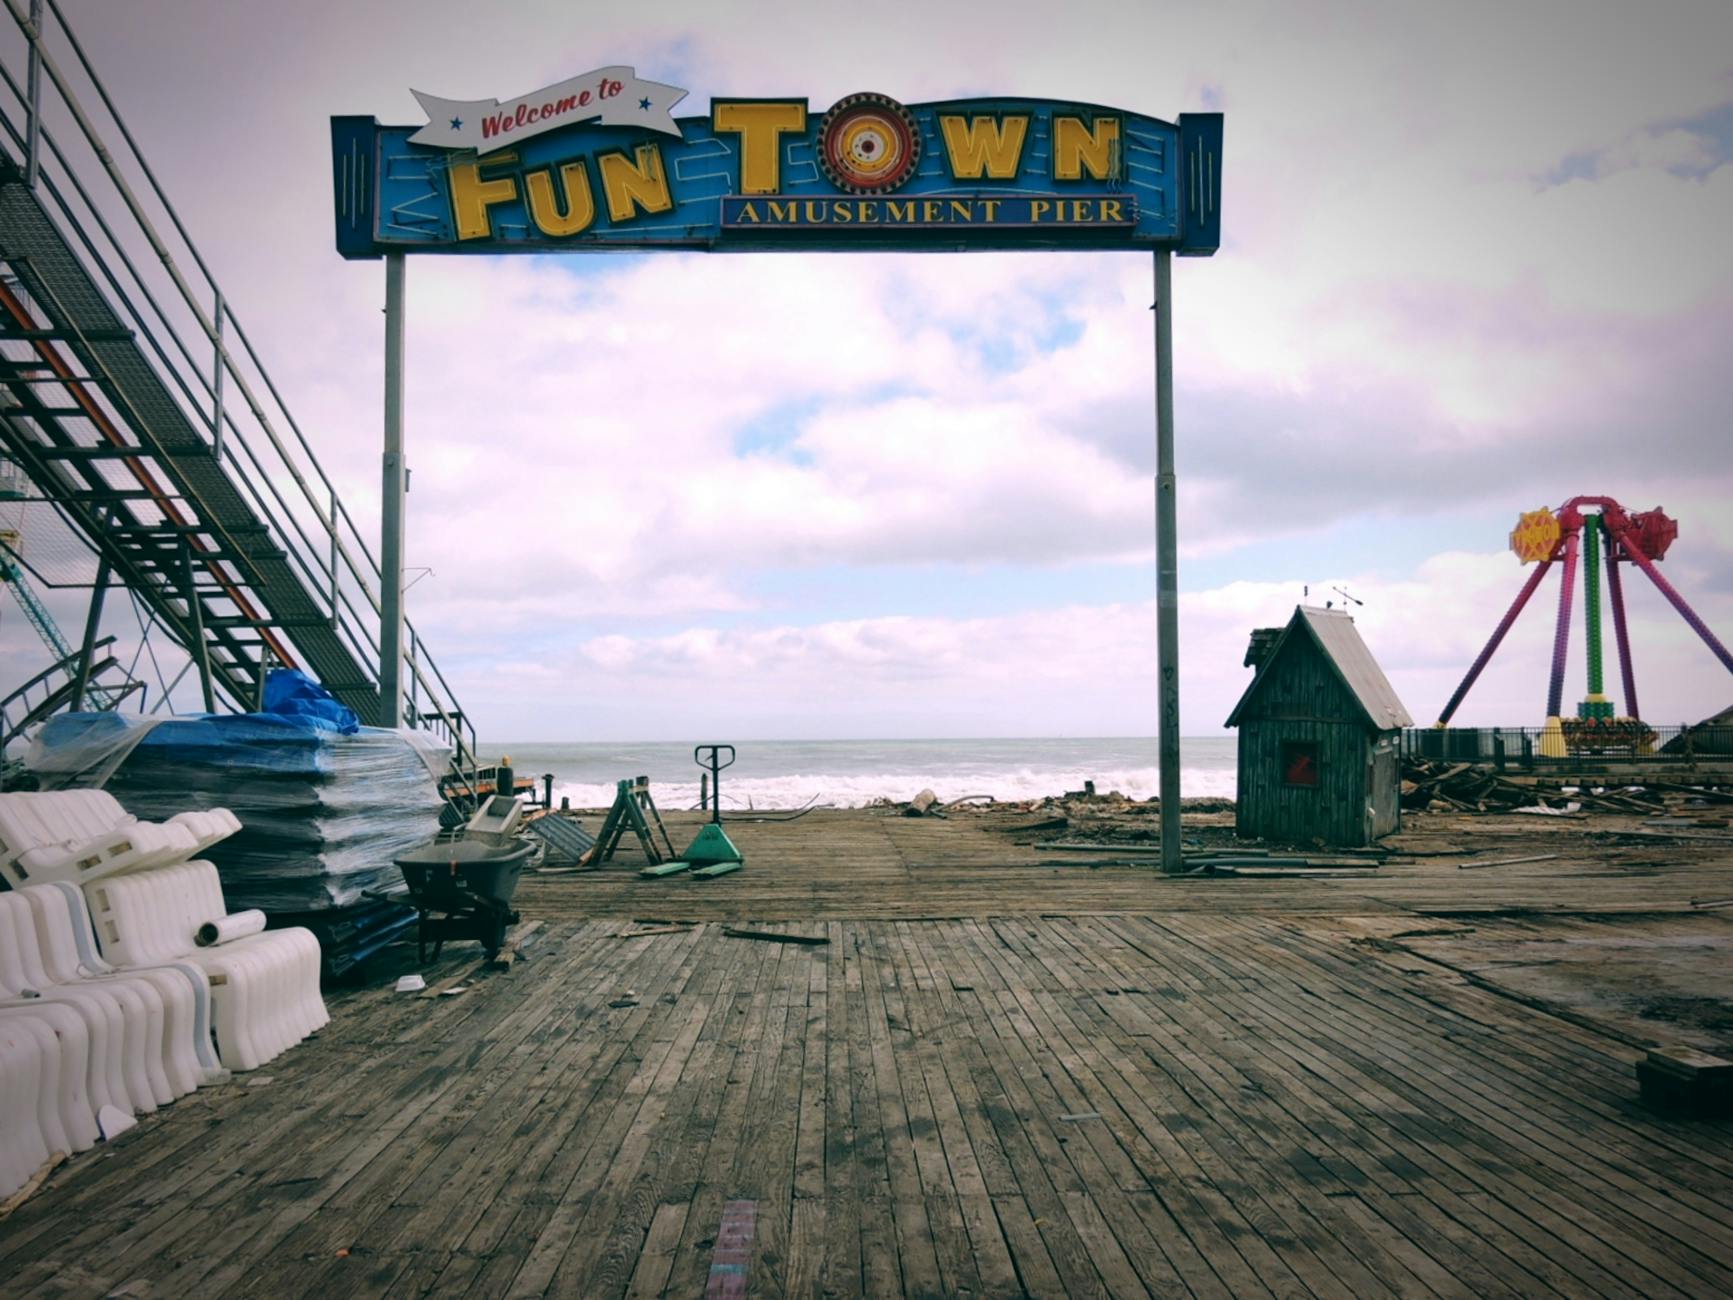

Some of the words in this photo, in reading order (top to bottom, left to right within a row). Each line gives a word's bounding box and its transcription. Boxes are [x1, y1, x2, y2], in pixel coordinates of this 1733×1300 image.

[481, 90, 592, 139] Welcome
[598, 78, 624, 100] to
[449, 143, 672, 240] FUN
[712, 92, 1121, 195] TOWN
[735, 200, 1001, 224] AMUSEMENT
[1030, 200, 1123, 223] PIER
